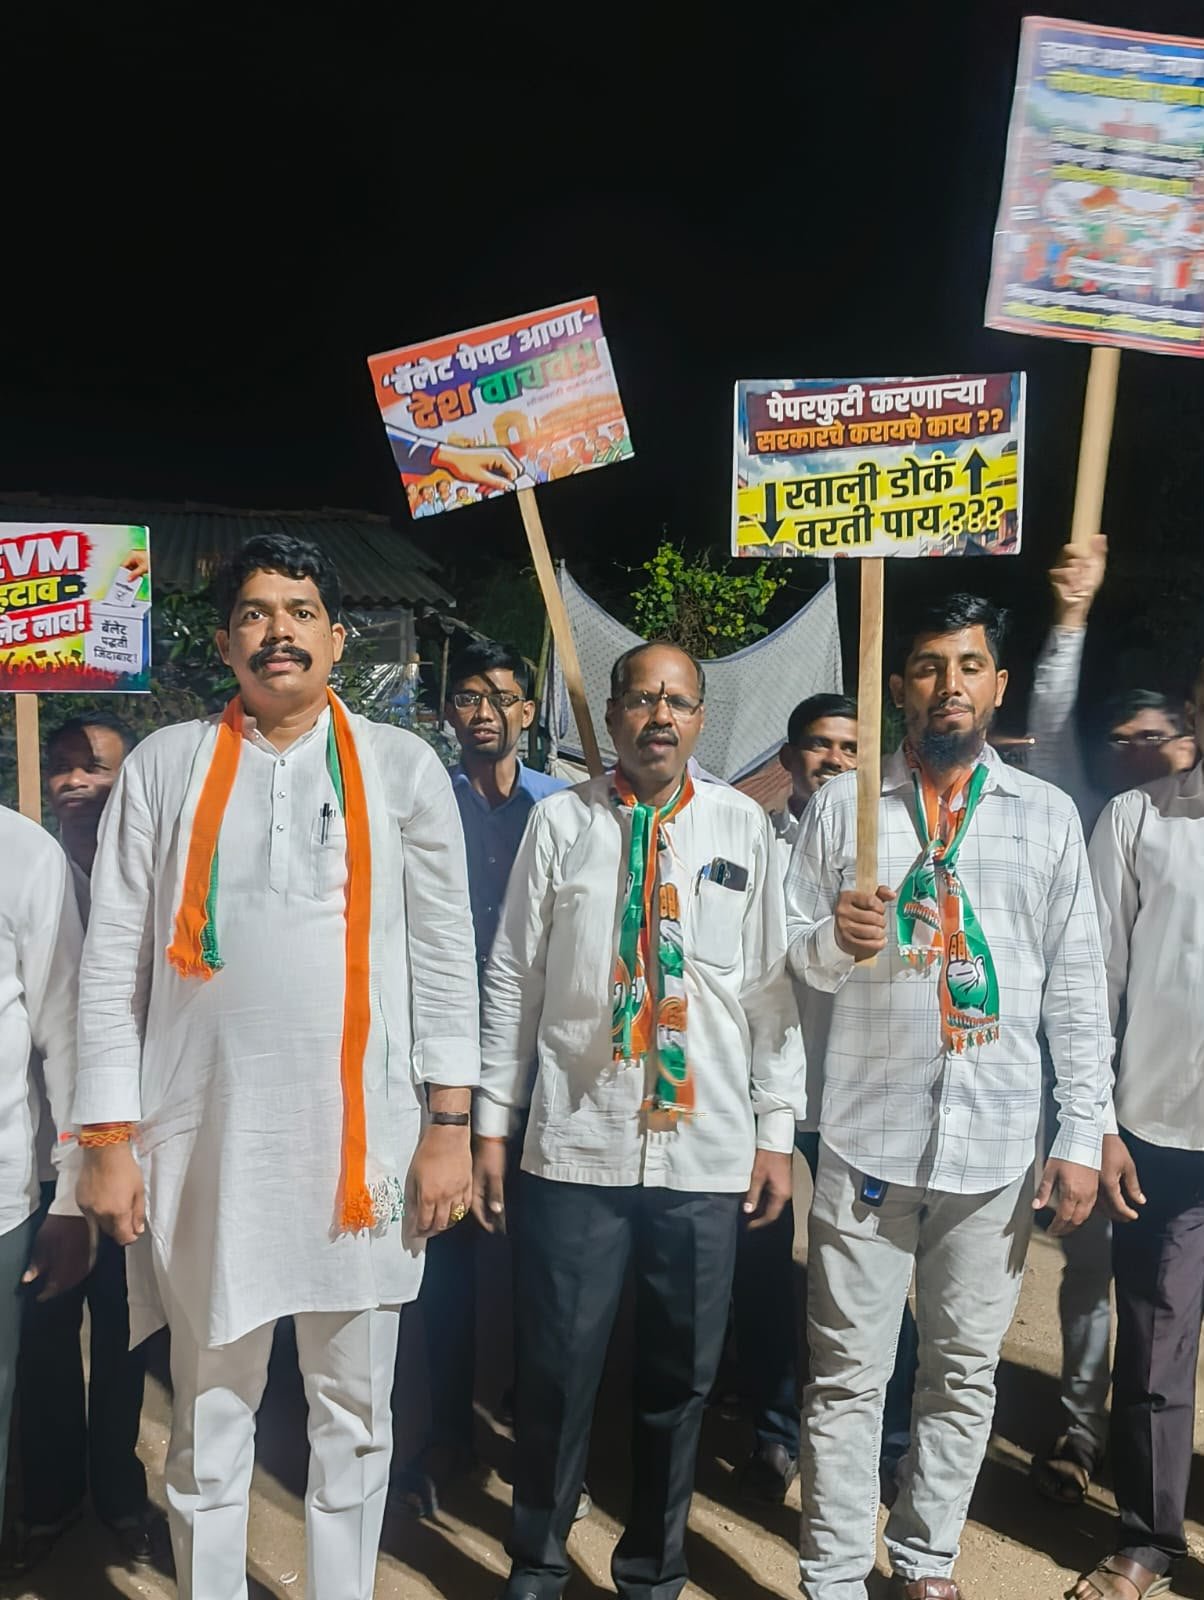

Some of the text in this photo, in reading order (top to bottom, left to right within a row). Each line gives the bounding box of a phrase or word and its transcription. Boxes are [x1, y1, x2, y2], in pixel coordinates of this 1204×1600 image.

[456, 335, 512, 371] पेपर
[408, 381, 477, 430] देश
[766, 378, 987, 426] पेपरफुटी करणाऱ्या
[755, 420, 846, 452] सरकारचे
[848, 413, 924, 445] करायचे
[926, 411, 973, 439] काय
[783, 453, 956, 509] खाली डोकं
[795, 504, 875, 549] वरती
[881, 505, 943, 539] पाय
[31, 604, 85, 638] लाव!
